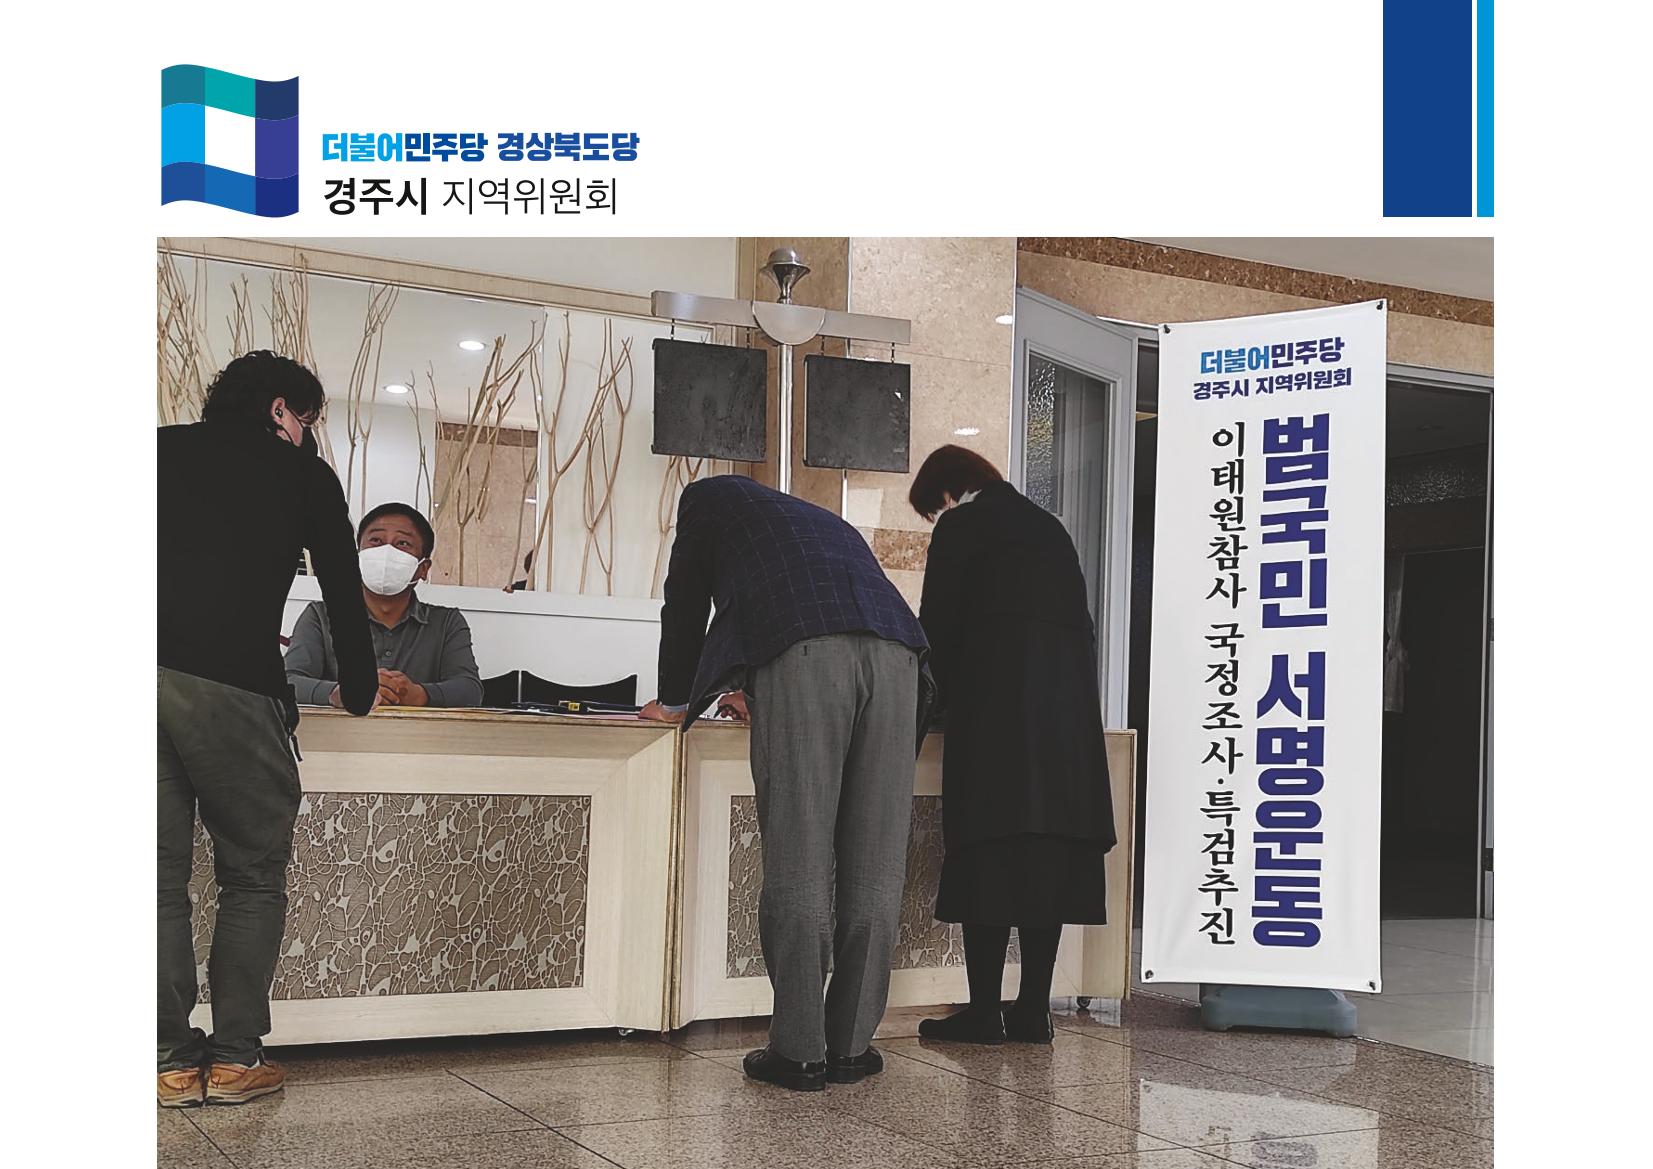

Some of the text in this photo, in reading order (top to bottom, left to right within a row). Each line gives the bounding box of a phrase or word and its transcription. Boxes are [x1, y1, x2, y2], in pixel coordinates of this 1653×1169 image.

[1193, 367, 1352, 401] 경주시 지역위원회
[1200, 337, 1346, 374] 더불어민주당
[1197, 421, 1249, 945] 이태원참사 국정조사·특검추진
[1251, 412, 1329, 948] 범국민 서명운동
